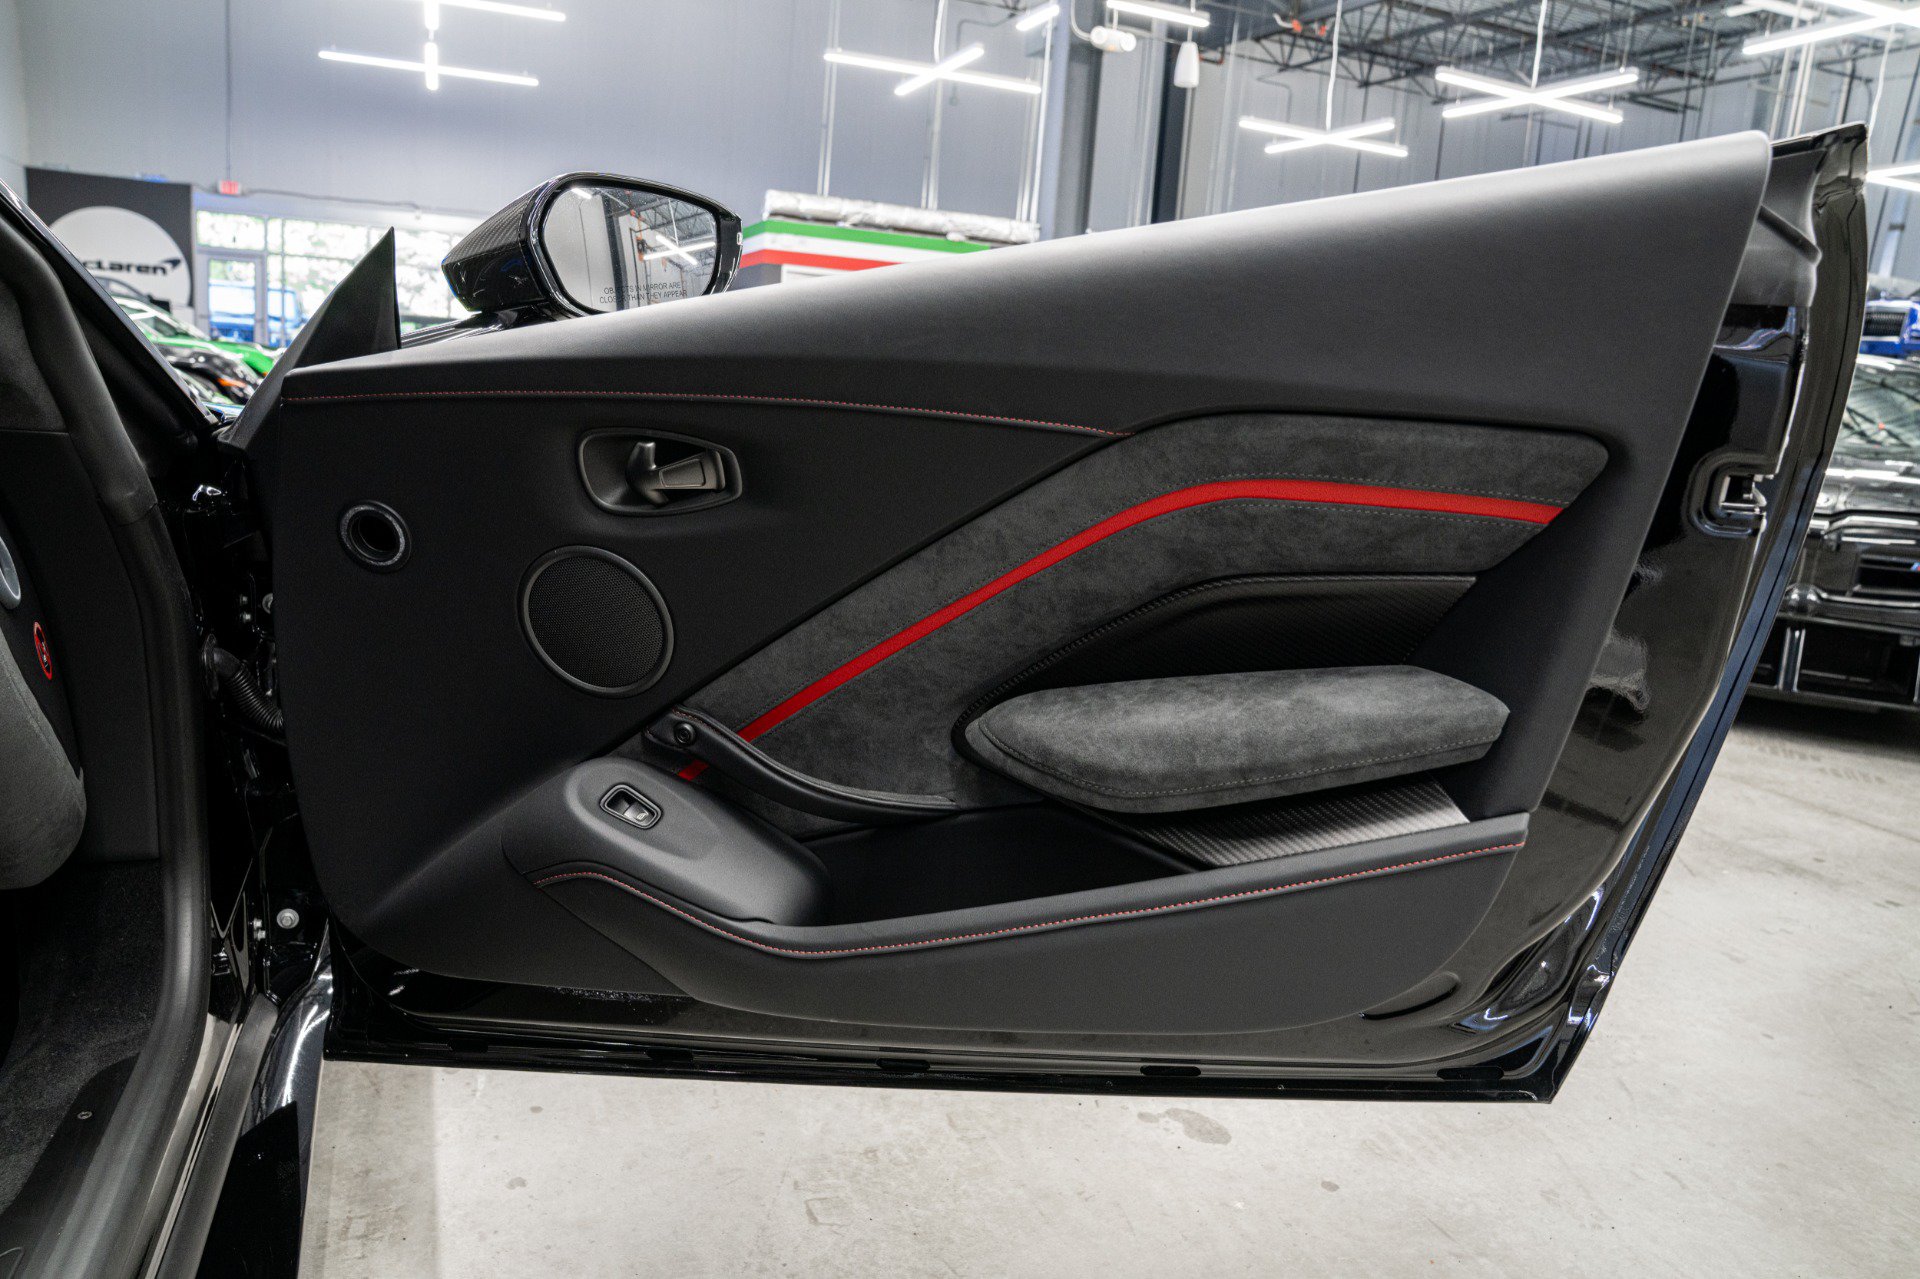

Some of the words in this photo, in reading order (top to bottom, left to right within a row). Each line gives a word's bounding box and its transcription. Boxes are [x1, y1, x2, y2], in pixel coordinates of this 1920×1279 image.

[82, 260, 167, 275] cLaren
[604, 285, 634, 294] OBCTS
[669, 281, 681, 289] ARE
[600, 294, 626, 304] CLOSR
[646, 291, 662, 300] THEY
[663, 289, 688, 298] APPEAR
